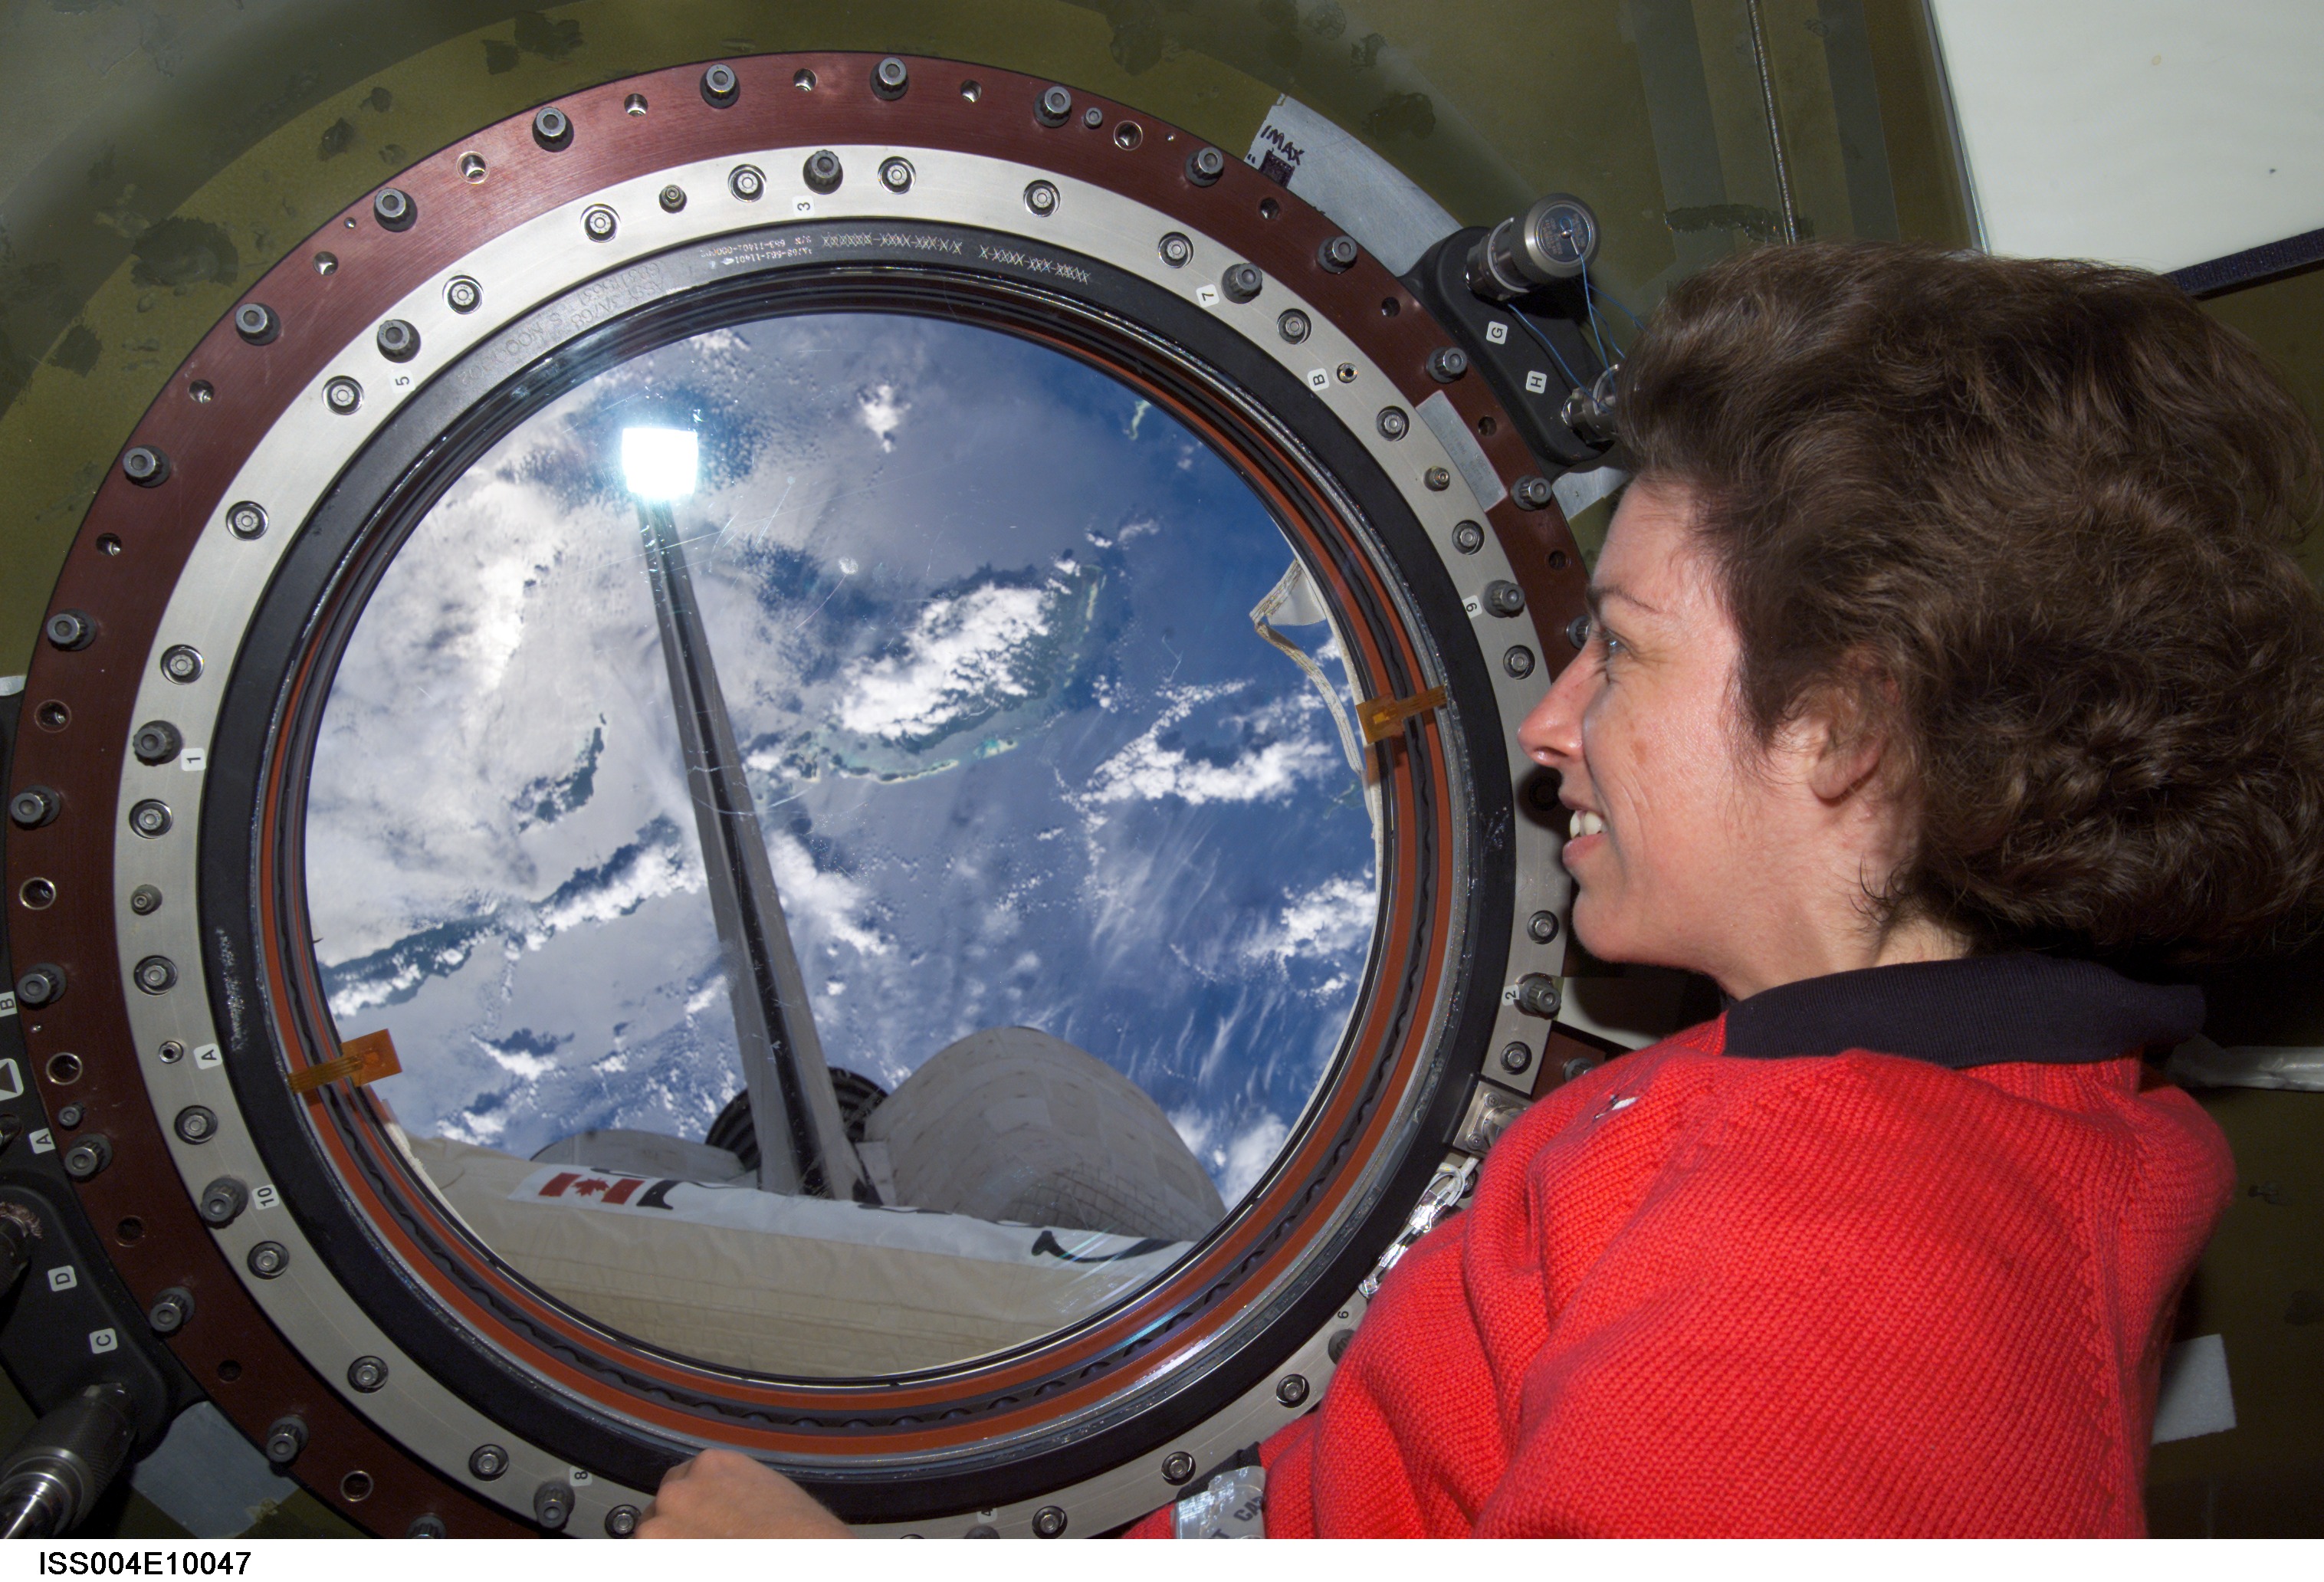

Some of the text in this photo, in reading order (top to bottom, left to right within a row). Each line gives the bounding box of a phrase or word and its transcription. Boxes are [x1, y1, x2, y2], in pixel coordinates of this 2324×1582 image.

[1260, 125, 1305, 166] IMAX
[797, 202, 811, 212] 3
[1200, 291, 1214, 302] 7
[1491, 327, 1504, 339] G
[396, 376, 410, 386] 5
[1312, 373, 1326, 386] B
[1530, 376, 1543, 388] H
[1466, 602, 1479, 613] 9
[186, 756, 201, 764] 1
[1505, 990, 1518, 1000] 2
[0, 997, 15, 1010] B
[201, 1049, 217, 1061] A
[35, 1133, 52, 1145] A
[257, 1186, 275, 1207] 10
[54, 1272, 71, 1285] D
[1337, 1310, 1350, 1320] 6
[96, 1334, 112, 1347] C
[573, 1470, 588, 1480] 8
